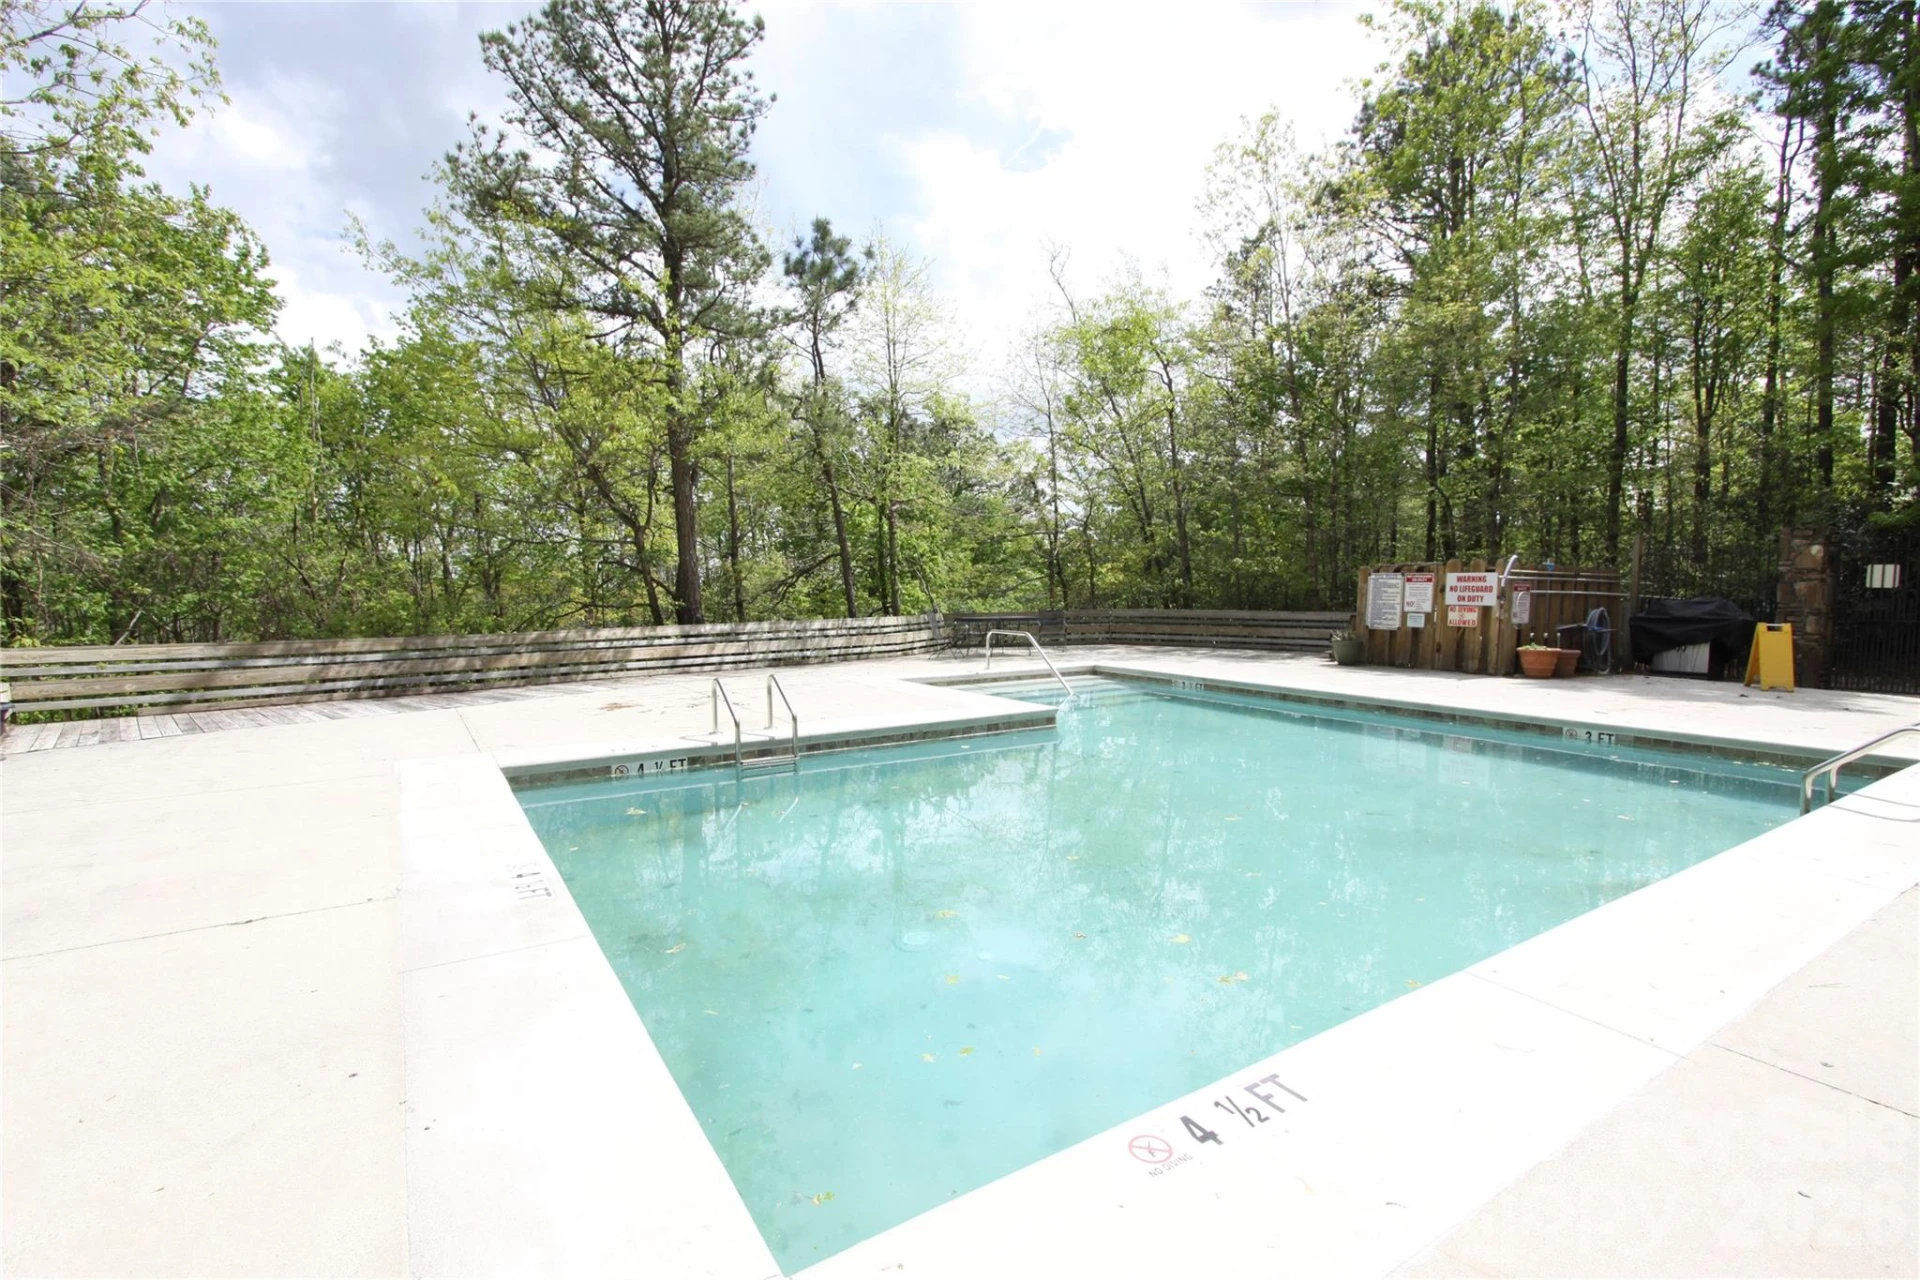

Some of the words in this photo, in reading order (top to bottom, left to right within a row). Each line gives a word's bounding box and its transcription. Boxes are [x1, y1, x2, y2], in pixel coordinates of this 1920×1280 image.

[1456, 575, 1487, 583] WARNING
[1459, 585, 1493, 593] LIFEGUARD
[1598, 732, 1614, 744] FT
[1179, 1115, 1223, 1145] 4
[1245, 1074, 1307, 1113] FT
[1148, 1167, 1163, 1177] NO
[1163, 1153, 1193, 1171] DIVING
